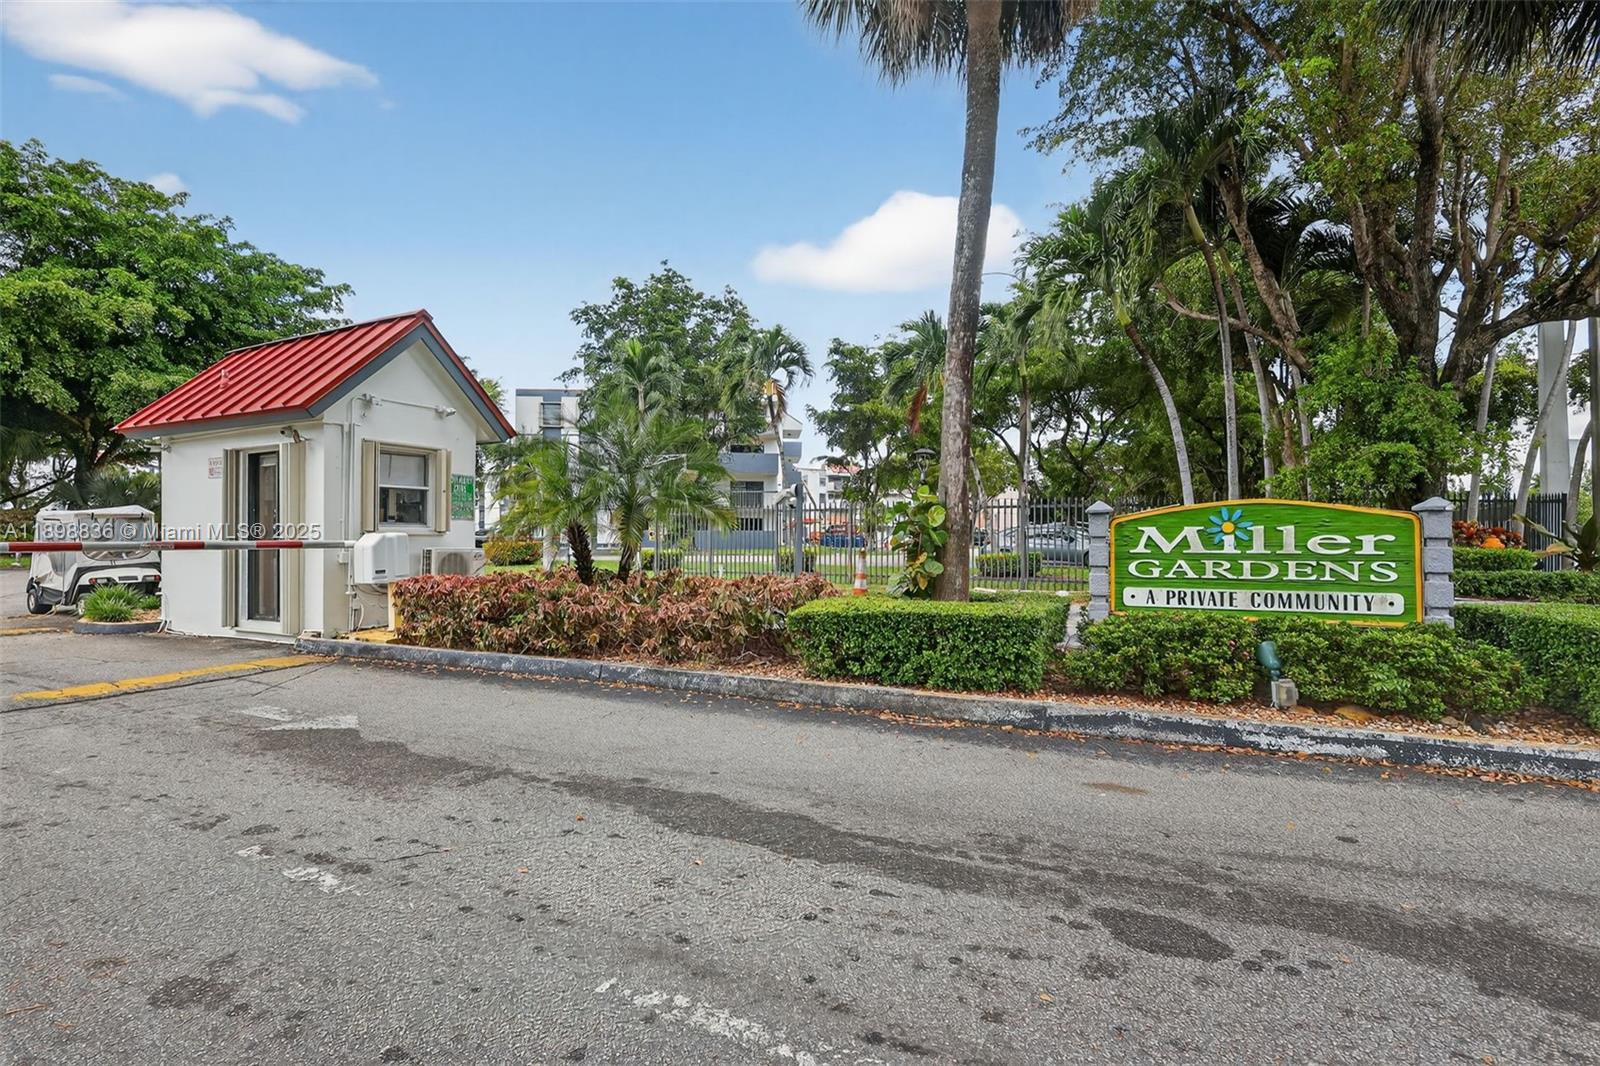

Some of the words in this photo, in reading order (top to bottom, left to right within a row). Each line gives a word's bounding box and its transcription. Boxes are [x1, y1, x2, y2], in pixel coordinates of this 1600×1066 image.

[1129, 525, 1397, 554] Miller
[1127, 559, 1400, 583] GARDENS
[1146, 589, 1156, 605] A
[1166, 589, 1238, 609] PRIVATE
[1250, 592, 1375, 612] COMMUNITY
